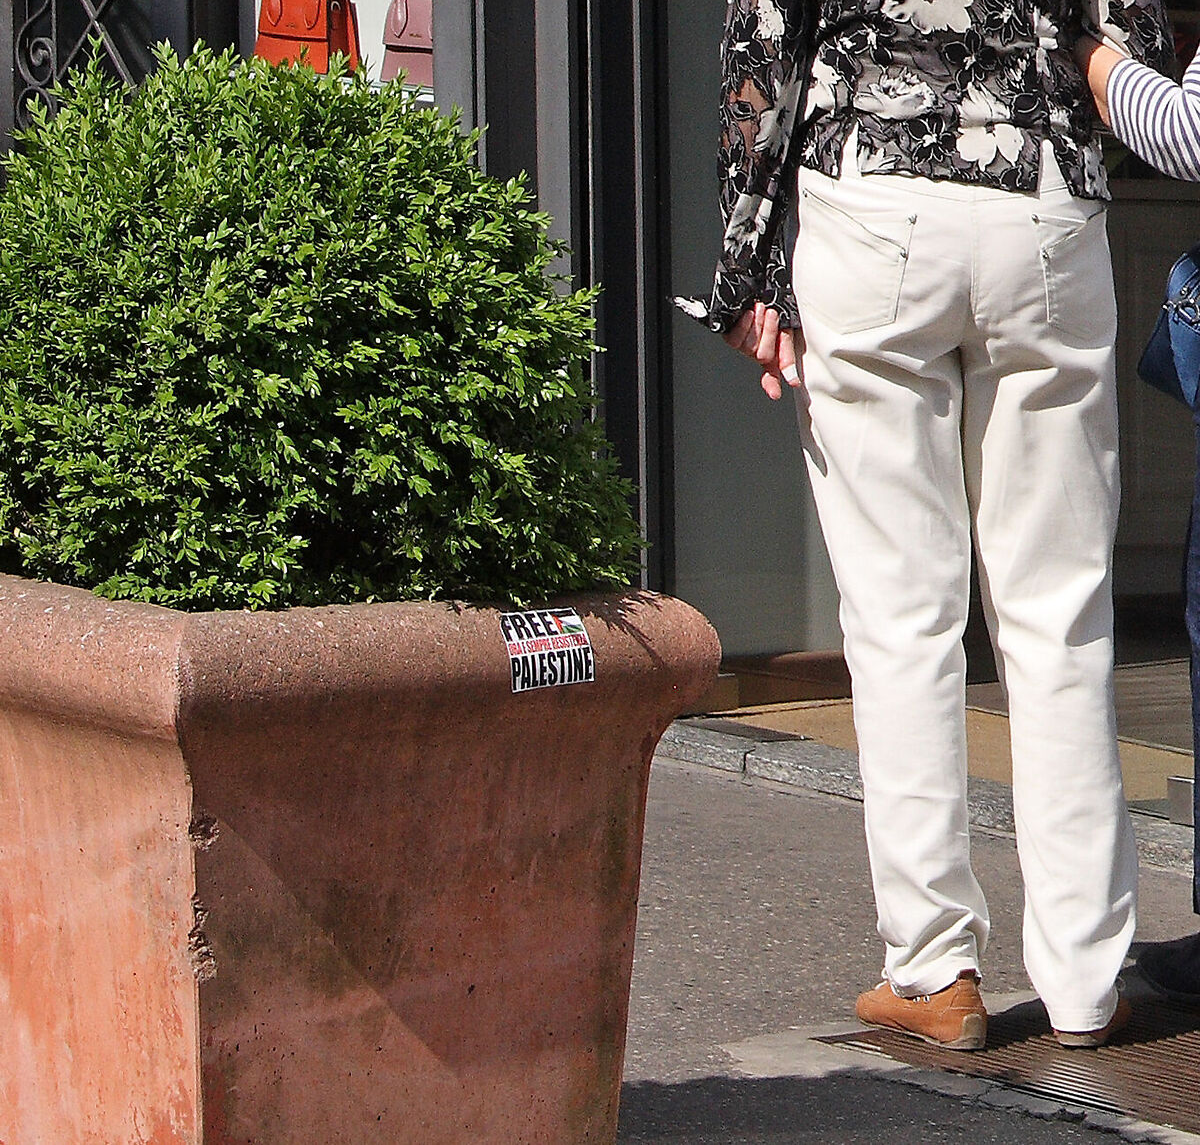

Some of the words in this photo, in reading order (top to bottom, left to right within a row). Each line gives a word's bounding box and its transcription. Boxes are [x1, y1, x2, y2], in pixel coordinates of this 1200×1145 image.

[500, 611, 558, 642] FREE
[526, 638, 552, 653] SEMPRE
[511, 646, 592, 691] PALESTINE
